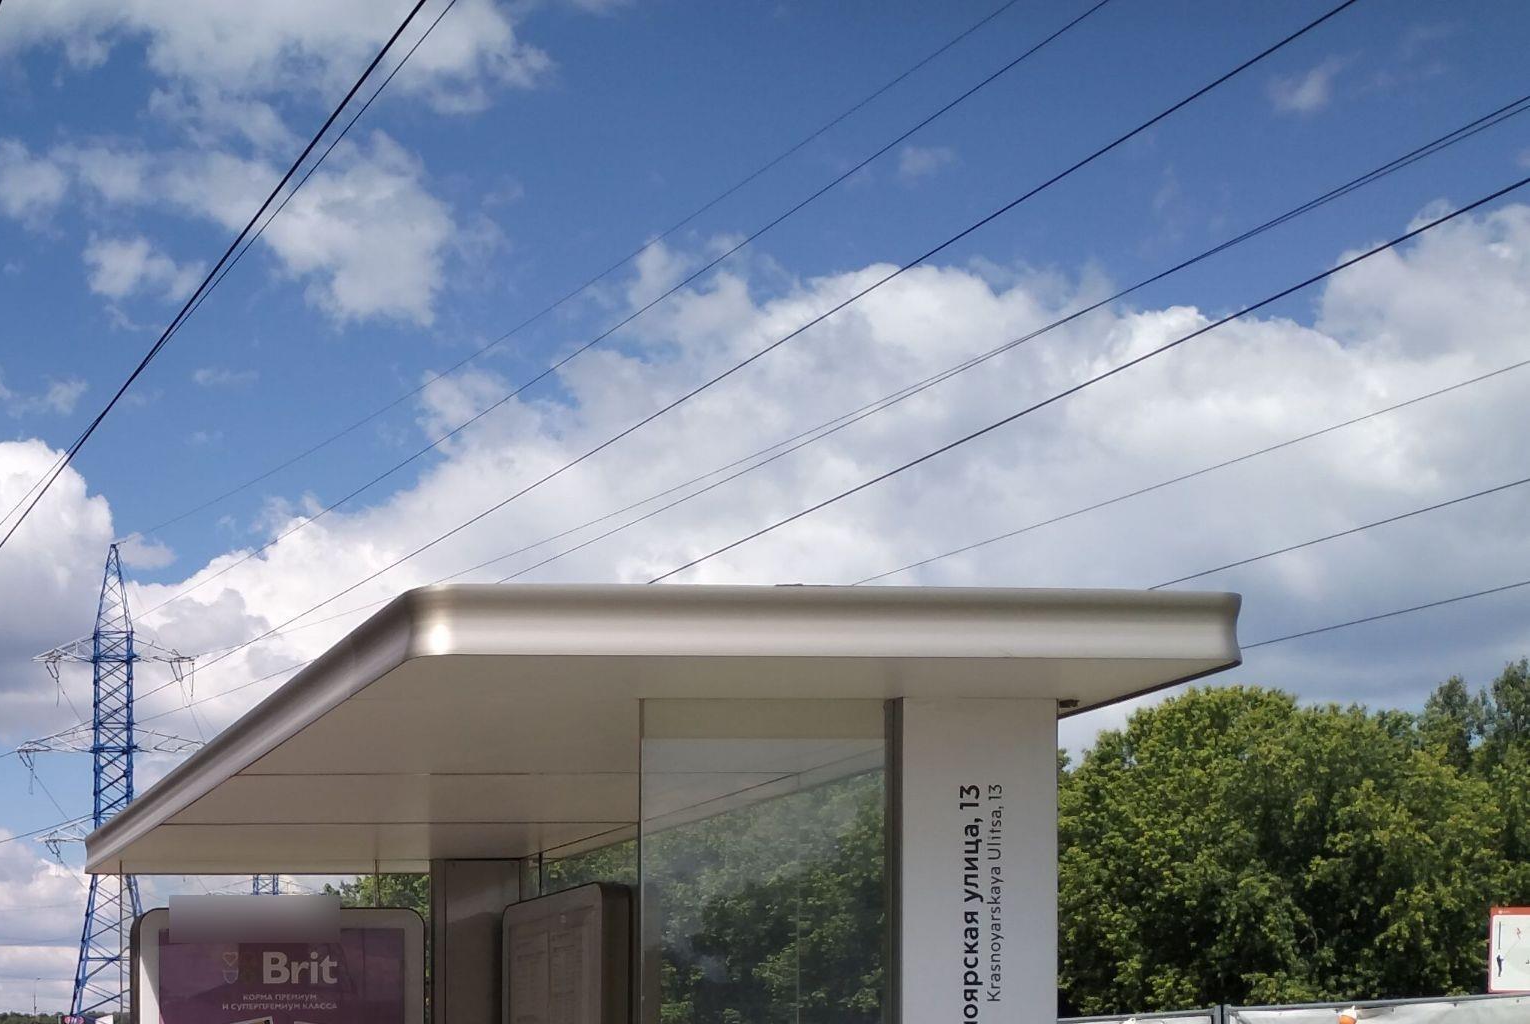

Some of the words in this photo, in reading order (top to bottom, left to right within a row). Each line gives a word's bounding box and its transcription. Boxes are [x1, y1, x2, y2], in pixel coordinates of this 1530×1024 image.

[959, 784, 981, 811] 13
[988, 784, 1003, 801] 13
[986, 805, 1005, 861] Ulitsa,
[963, 817, 984, 904] улица,
[986, 866, 1005, 1002] Krasnoyarskaya
[262, 951, 338, 985] Brit
[242, 993, 273, 1001] КОРМА
[274, 993, 318, 1002] ПРЕМИУМ
[302, 1002, 338, 1010] КЛАССА
